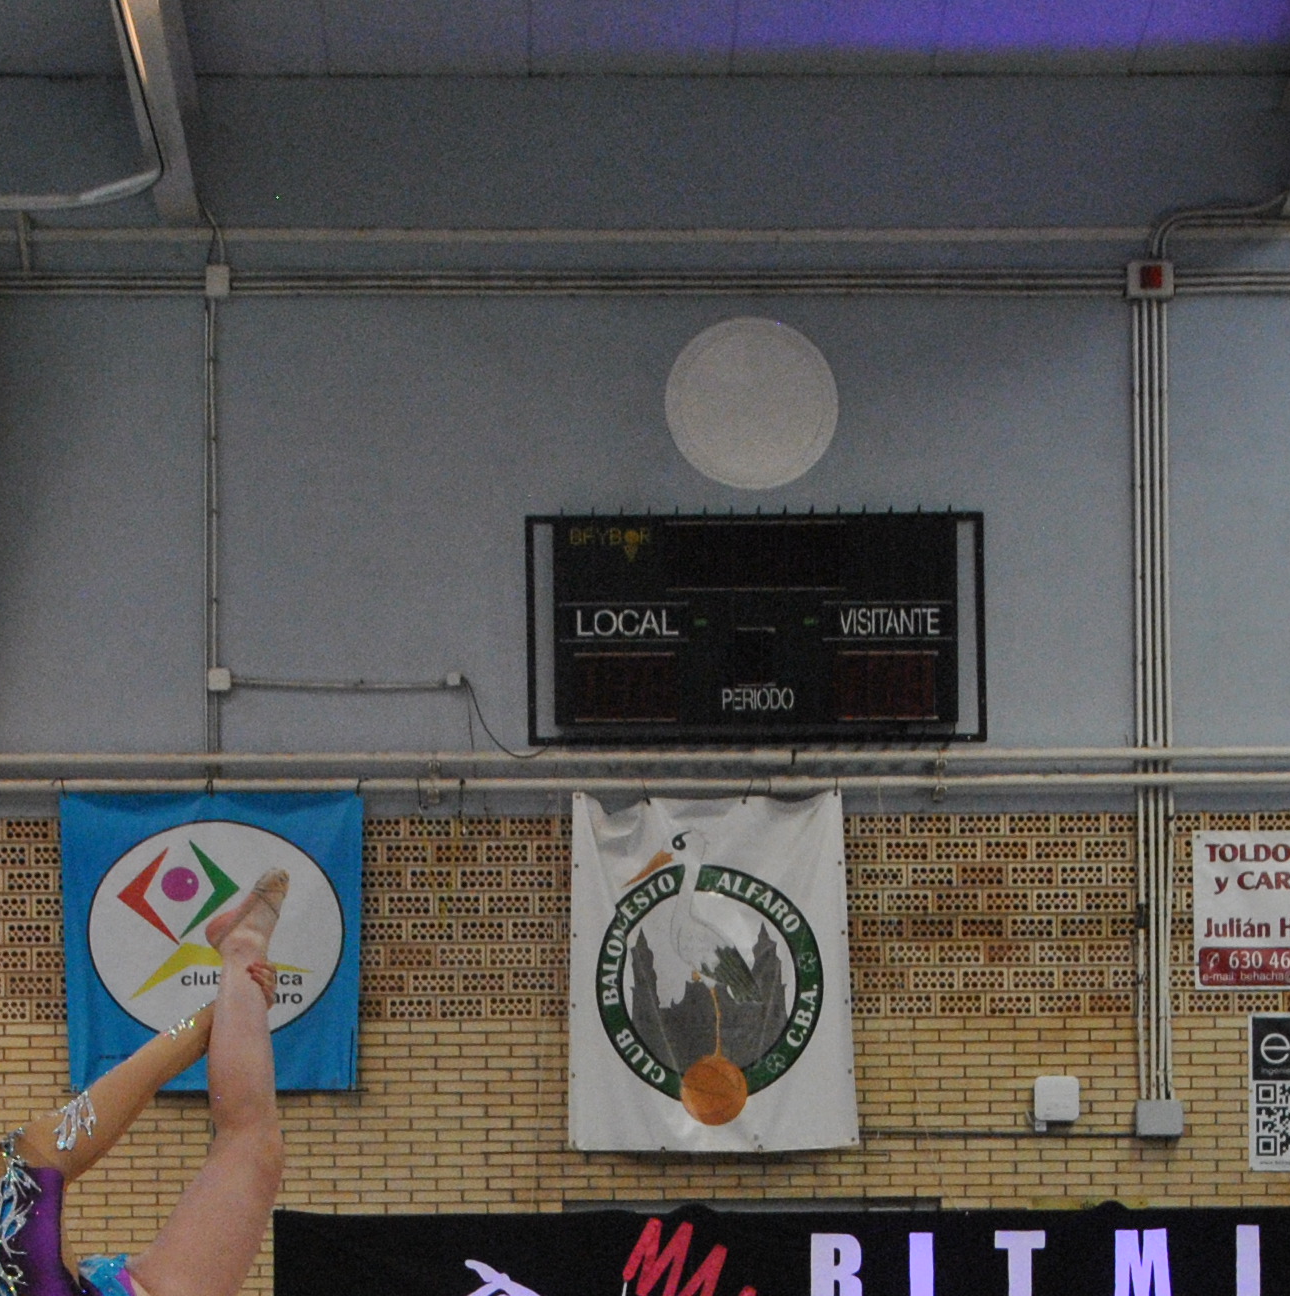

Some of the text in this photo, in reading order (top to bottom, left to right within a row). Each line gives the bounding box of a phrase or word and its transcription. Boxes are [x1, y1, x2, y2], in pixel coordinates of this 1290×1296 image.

[576, 609, 679, 638] LOCAL
[840, 608, 940, 636] VISITANTE
[721, 688, 794, 713] PERIODO
[1214, 876, 1228, 895] y
[716, 872, 802, 934] ALFARO
[1204, 917, 1271, 938] Julián
[1228, 949, 1263, 969] 630
[786, 983, 819, 1049] C.B.A.
[615, 1027, 667, 1085] CLUB
